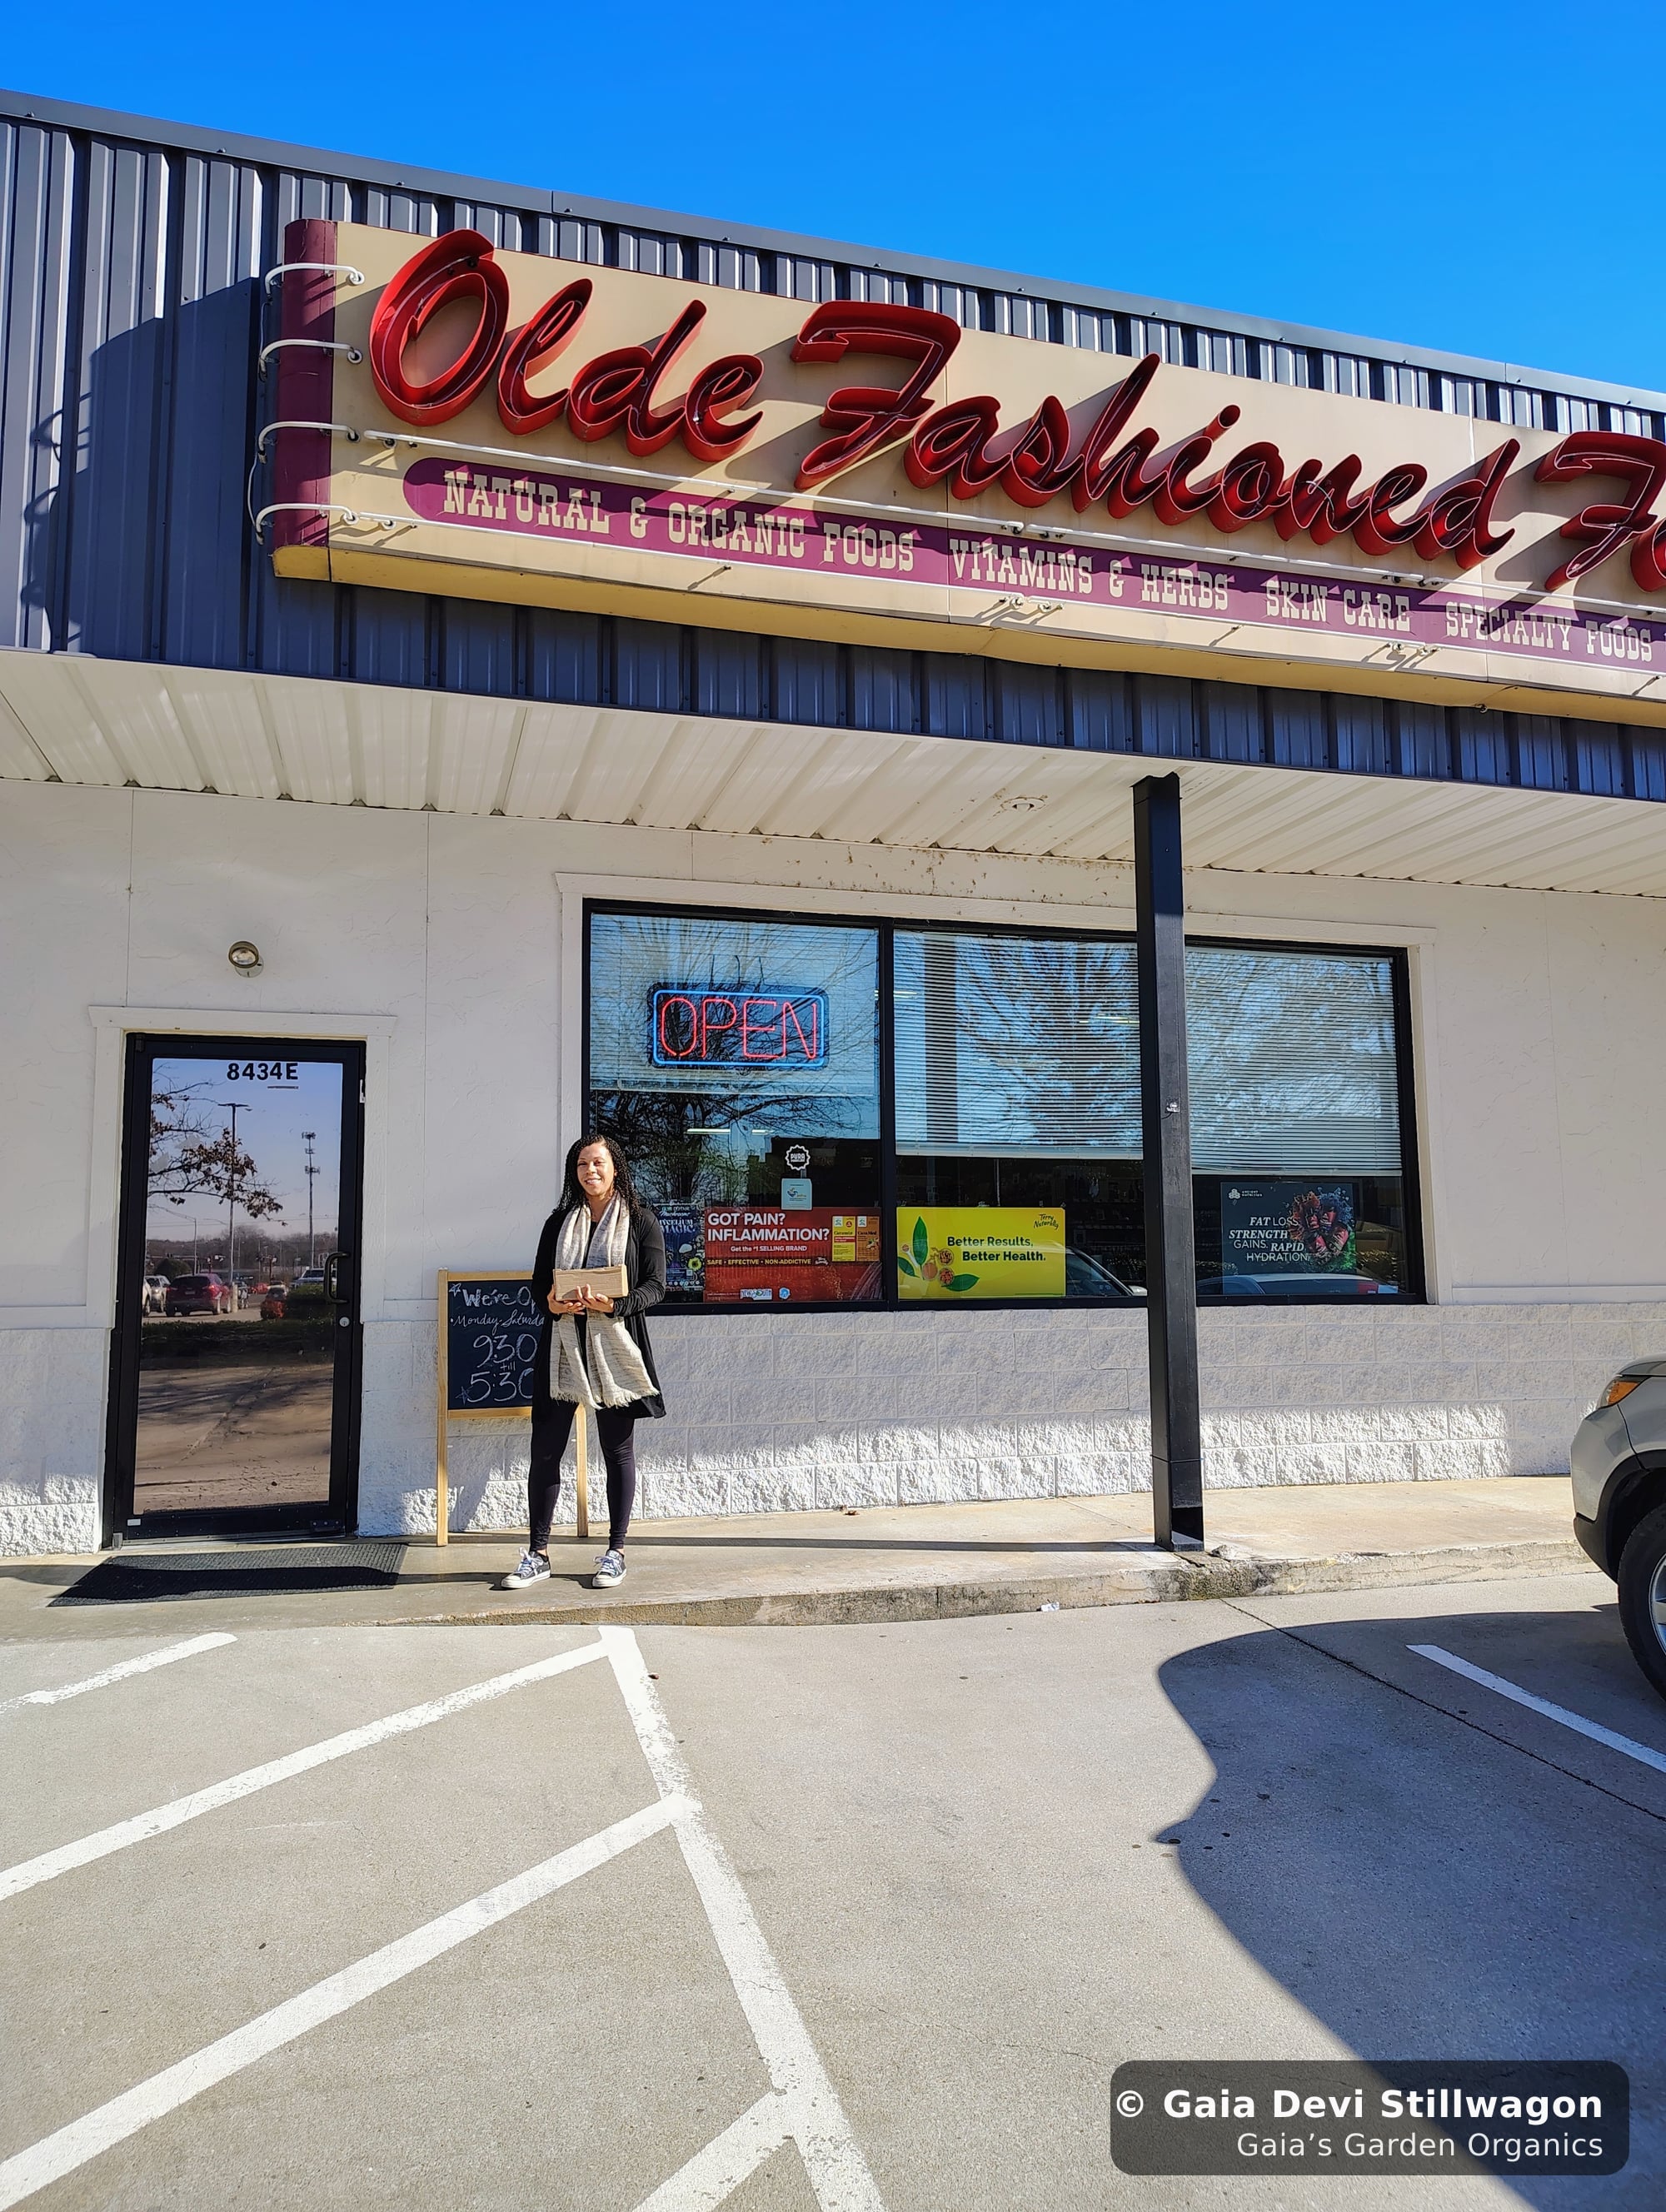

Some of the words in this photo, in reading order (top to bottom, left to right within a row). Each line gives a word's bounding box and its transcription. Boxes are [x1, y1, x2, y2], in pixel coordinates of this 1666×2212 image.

[370, 228, 764, 463] Olde
[791, 301, 1519, 570] Fashioned
[443, 471, 610, 535] NATURAL
[629, 496, 649, 539] &
[668, 500, 806, 559] ORGANIC
[822, 523, 915, 574] FOODS
[949, 538, 1094, 595] VITAMINS
[1108, 560, 1124, 598] &
[1140, 563, 1230, 612] HERBS
[1265, 579, 1329, 623] SKIN
[1342, 587, 1412, 633] CARE
[1445, 601, 1573, 652] SPECIALTY
[1585, 620, 1654, 663] FOODS
[661, 996, 818, 1060] OPEN
[227, 1062, 298, 1081] 8434E
[707, 1213, 742, 1226] GOT
[744, 1213, 786, 1226] PAIN?
[1039, 1213, 1055, 1222] Terry
[1250, 1217, 1271, 1226] FAT
[1033, 1219, 1059, 1231] Naturally
[707, 1228, 831, 1242] INFLAMMATION?
[1229, 1229, 1289, 1239] STRENGTH
[947, 1236, 985, 1248] Better
[987, 1236, 1034, 1248] Results,
[1234, 1239, 1269, 1249] GAINS.
[1270, 1242, 1304, 1252] RAPID
[962, 1251, 1001, 1262] Better
[1003, 1251, 1046, 1262] Health.
[473, 1333, 538, 1368] 9:30
[500, 1361, 516, 1372] till
